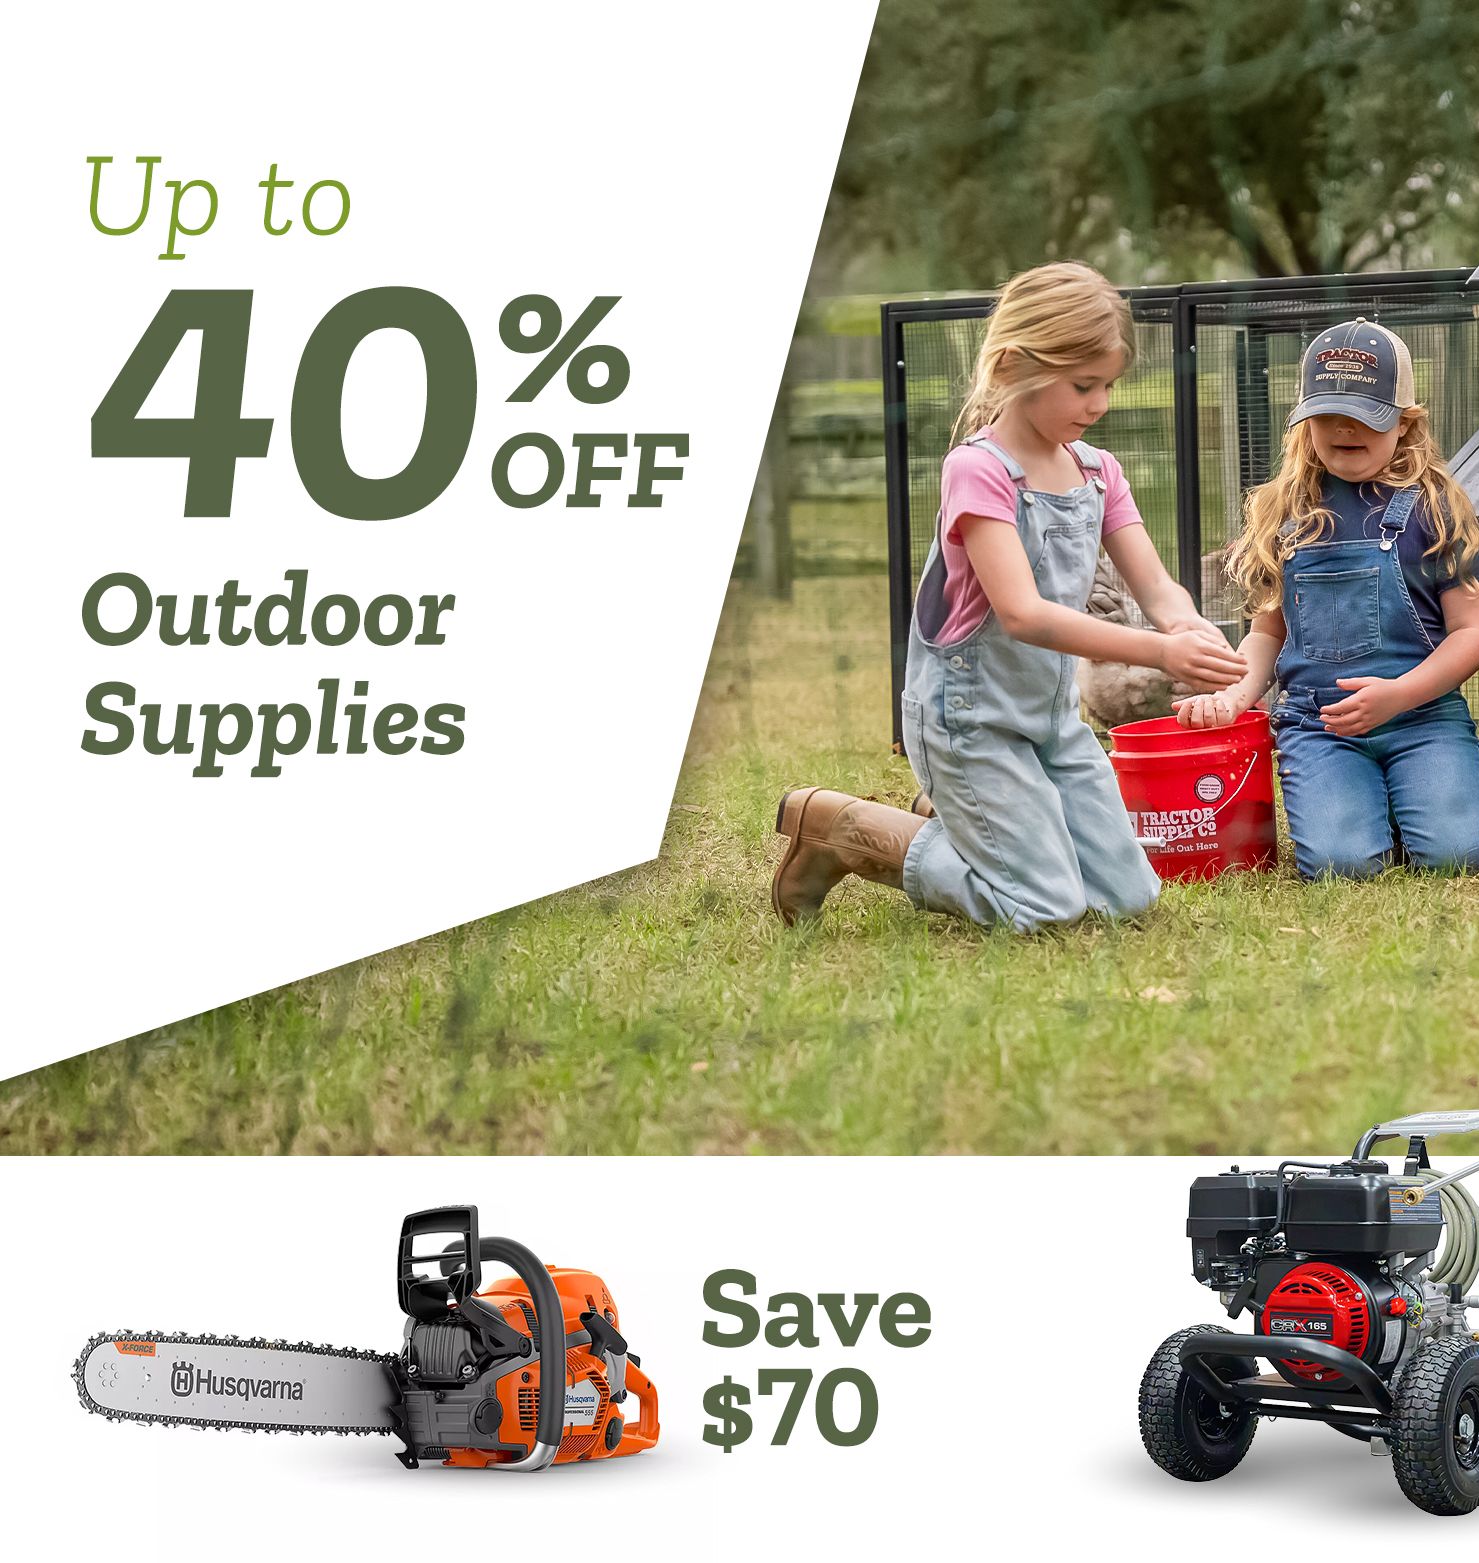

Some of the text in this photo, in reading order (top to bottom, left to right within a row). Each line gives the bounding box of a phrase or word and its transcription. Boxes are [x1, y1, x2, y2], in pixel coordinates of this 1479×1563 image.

[1316, 348, 1378, 368] TRACTOR
[1315, 373, 1377, 384] SUPPLY COMPANY
[1141, 808, 1215, 825] TRACTOR
[1143, 824, 1194, 840] SUPPLY
[1176, 844, 1195, 853] Out
[1196, 842, 1219, 851] Here
[1271, 1318, 1327, 1332] CRX 165
[122, 1344, 154, 1353] X-FORCE
[196, 1369, 304, 1402] Husqvarna
[568, 1395, 594, 1403] Husqvarna
